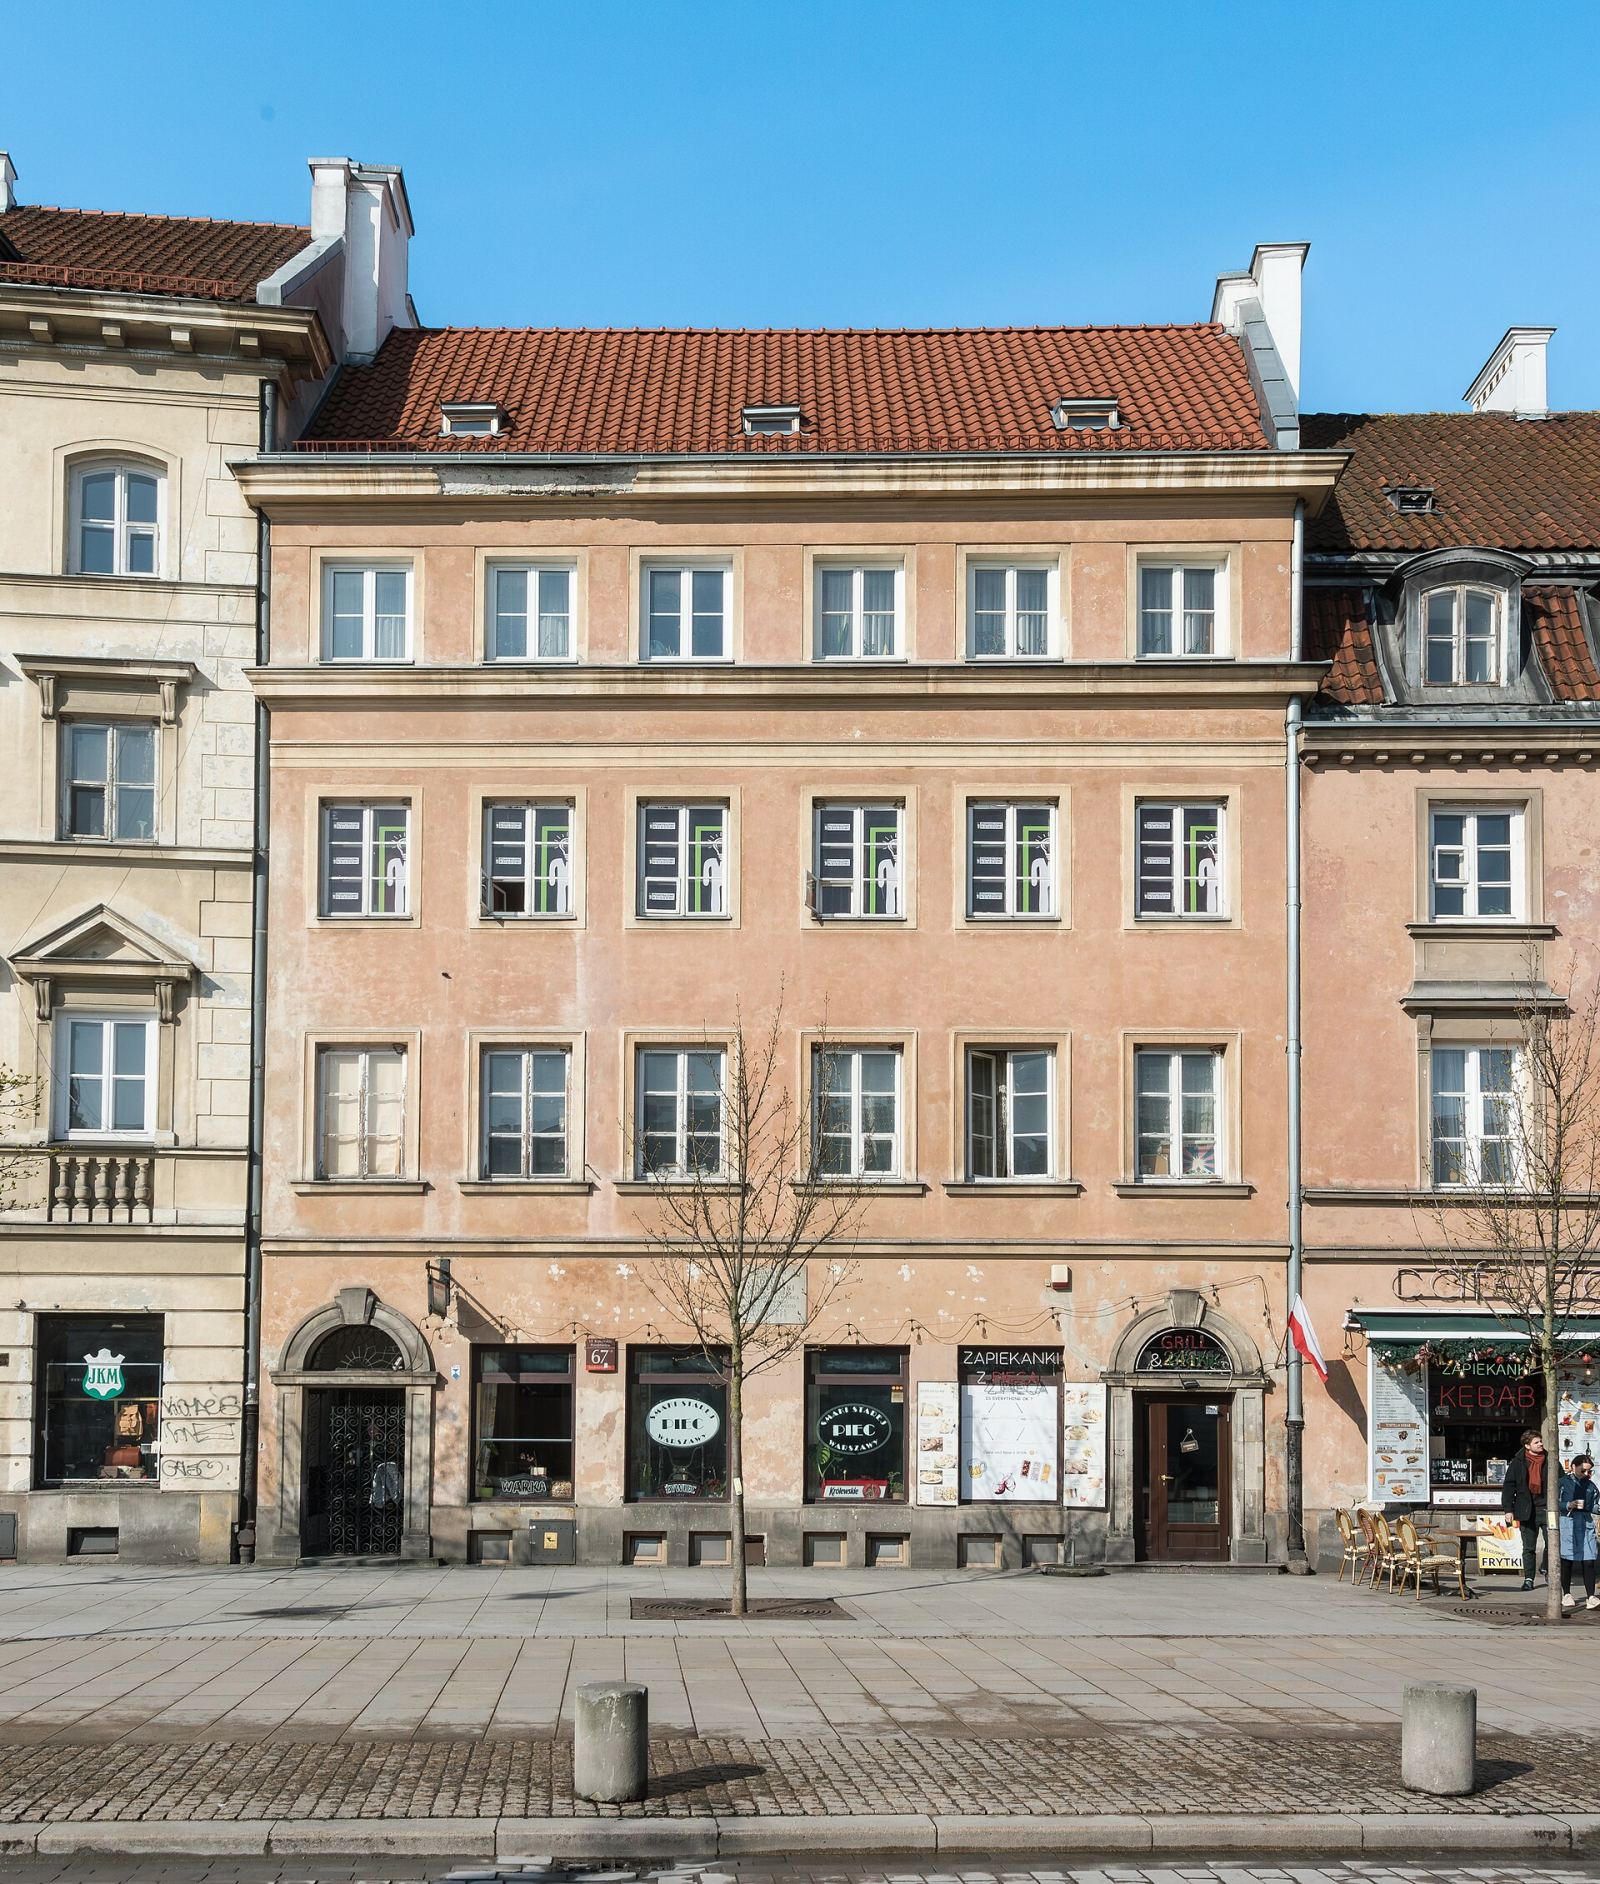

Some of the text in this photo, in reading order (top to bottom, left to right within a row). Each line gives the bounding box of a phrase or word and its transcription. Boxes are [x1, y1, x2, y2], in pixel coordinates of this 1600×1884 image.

[591, 1349, 609, 1364] 67
[963, 1350, 1060, 1365] ZAPIEKANKI
[88, 1367, 119, 1385] JKM
[976, 1371, 987, 1385] Z
[1440, 1385, 1535, 1408] KEBAB
[650, 1401, 677, 1419] SMAKI
[820, 1406, 887, 1426] SMAKI STAREJ
[662, 1418, 704, 1430] PIEC
[832, 1423, 876, 1437] PIEC
[658, 1433, 706, 1445] WARSZAWY
[829, 1439, 878, 1452] WARSZAWY
[501, 1480, 547, 1494] WARKA
[828, 1486, 859, 1496] Królewskie
[1482, 1557, 1522, 1567] FRYTKI
